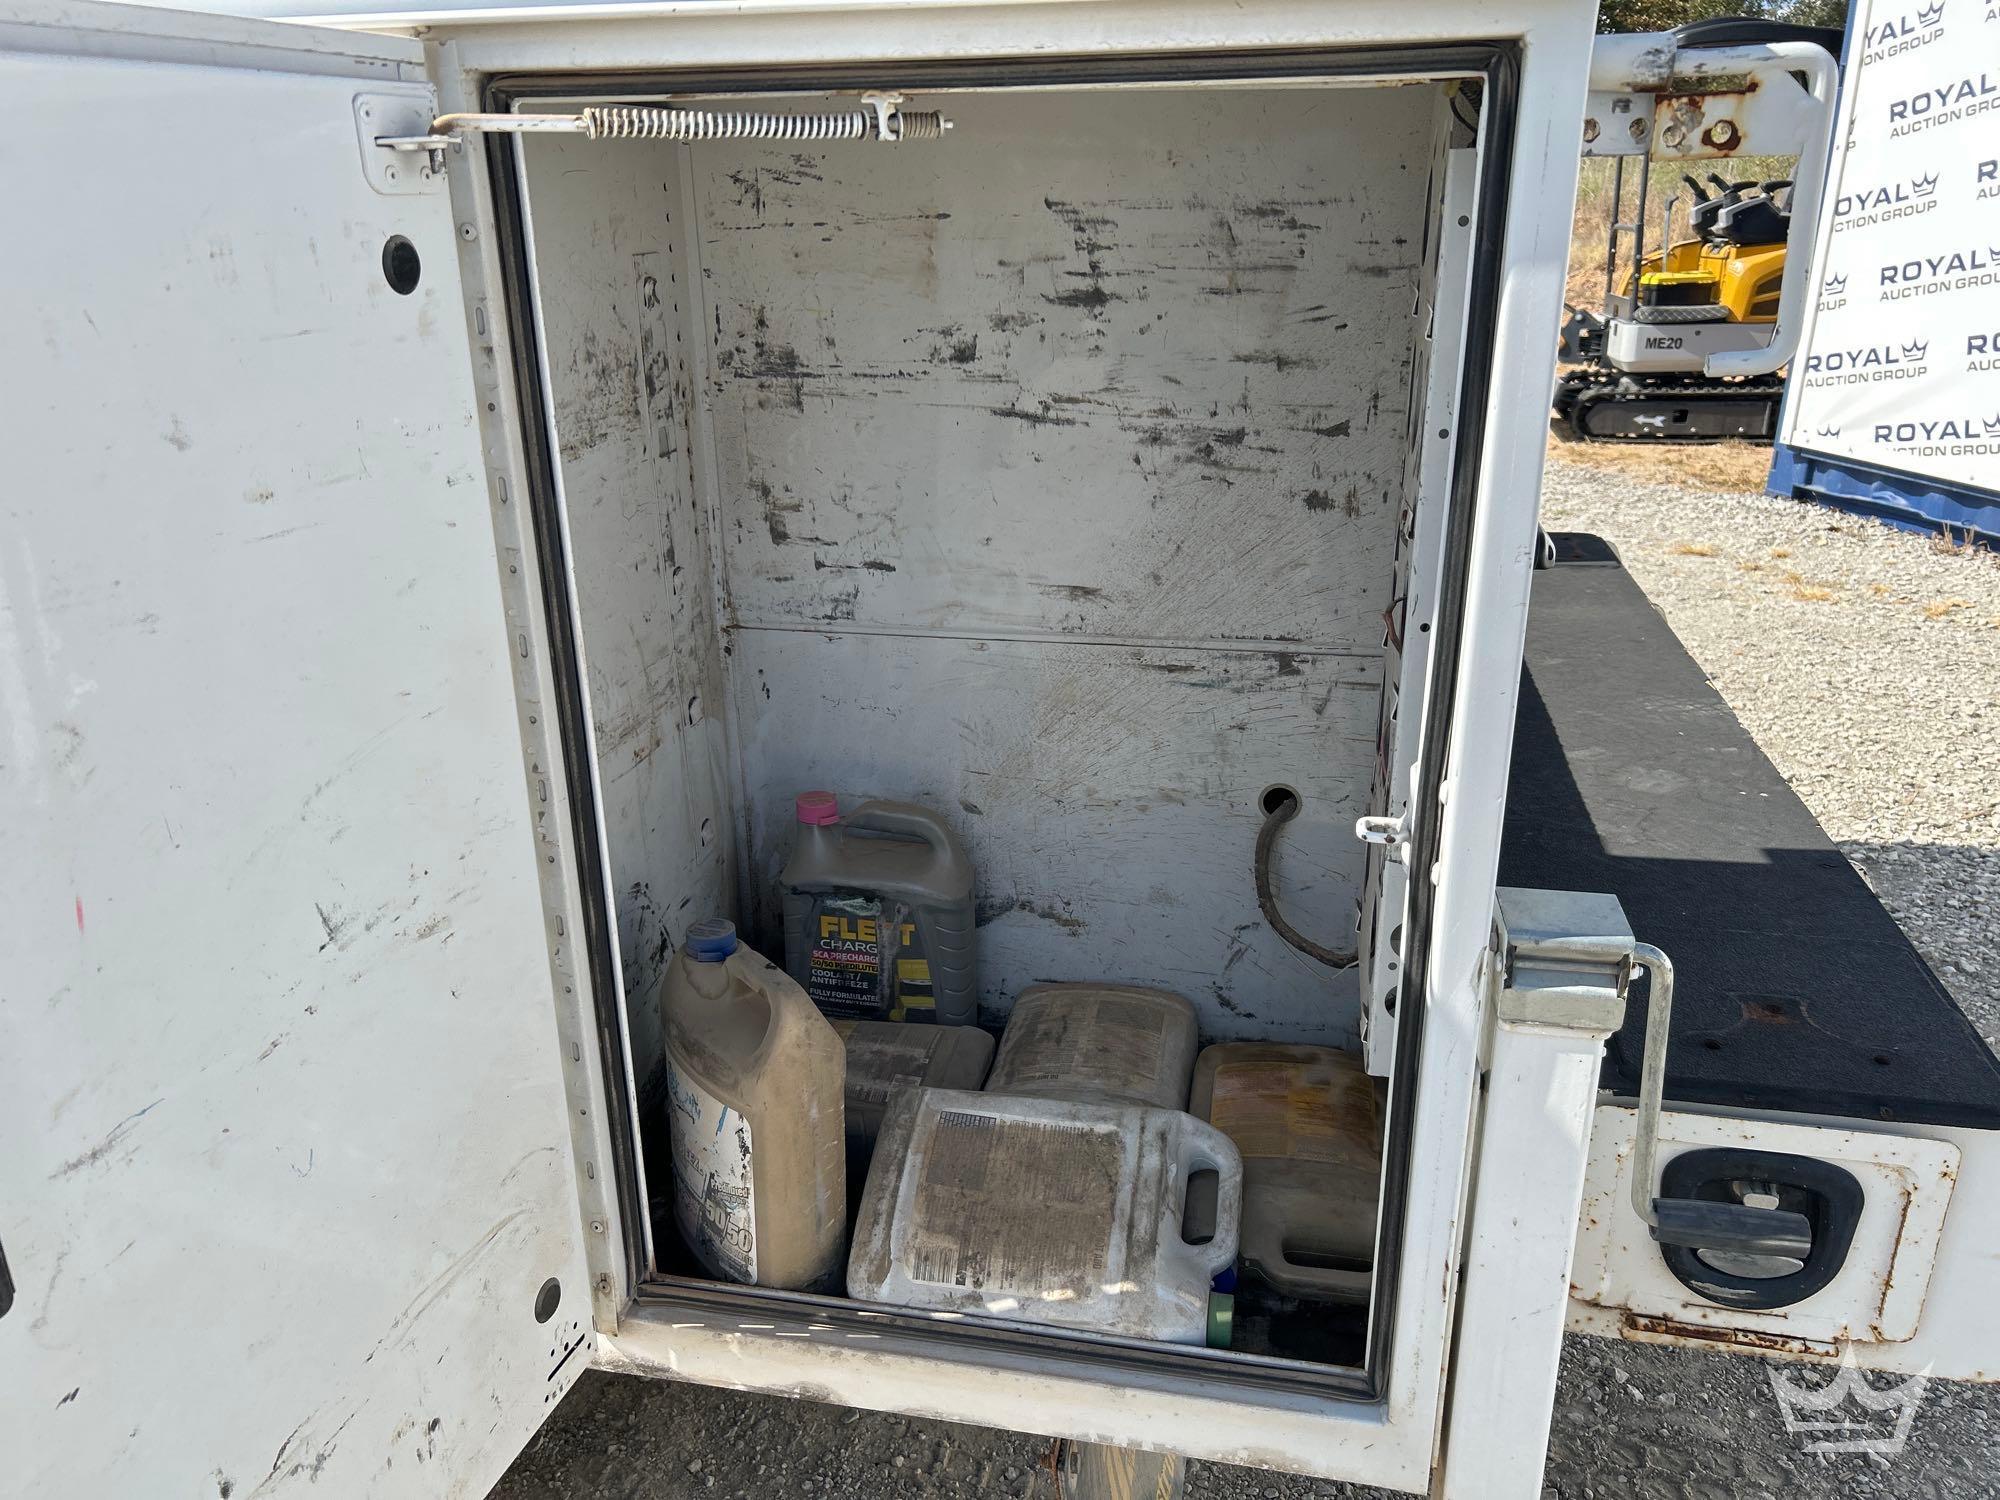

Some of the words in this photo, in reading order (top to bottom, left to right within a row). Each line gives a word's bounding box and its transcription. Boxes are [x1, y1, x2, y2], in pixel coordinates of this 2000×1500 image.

[1888, 28, 1944, 57] GROUP
[1890, 74, 1997, 122] ROYAL
[1890, 108, 1961, 139] AUCTION
[1834, 184, 1909, 216] OYAL
[1882, 200, 1937, 221] GROUP
[1880, 250, 1986, 286] ROYAL
[1880, 280, 1951, 302] AUCTION
[1645, 337, 1683, 350] ME20
[1806, 346, 1899, 373] ROYAL
[1805, 372, 1869, 388] AUCTION
[1873, 366, 1927, 382] GROUP
[1875, 420, 1980, 442] ROYAL
[820, 915, 916, 946] FLET
[820, 940, 878, 954] CHARG
[812, 960, 833, 968] 50/50
[810, 987, 830, 997] FULLY
[705, 1199, 753, 1253] 50/50
